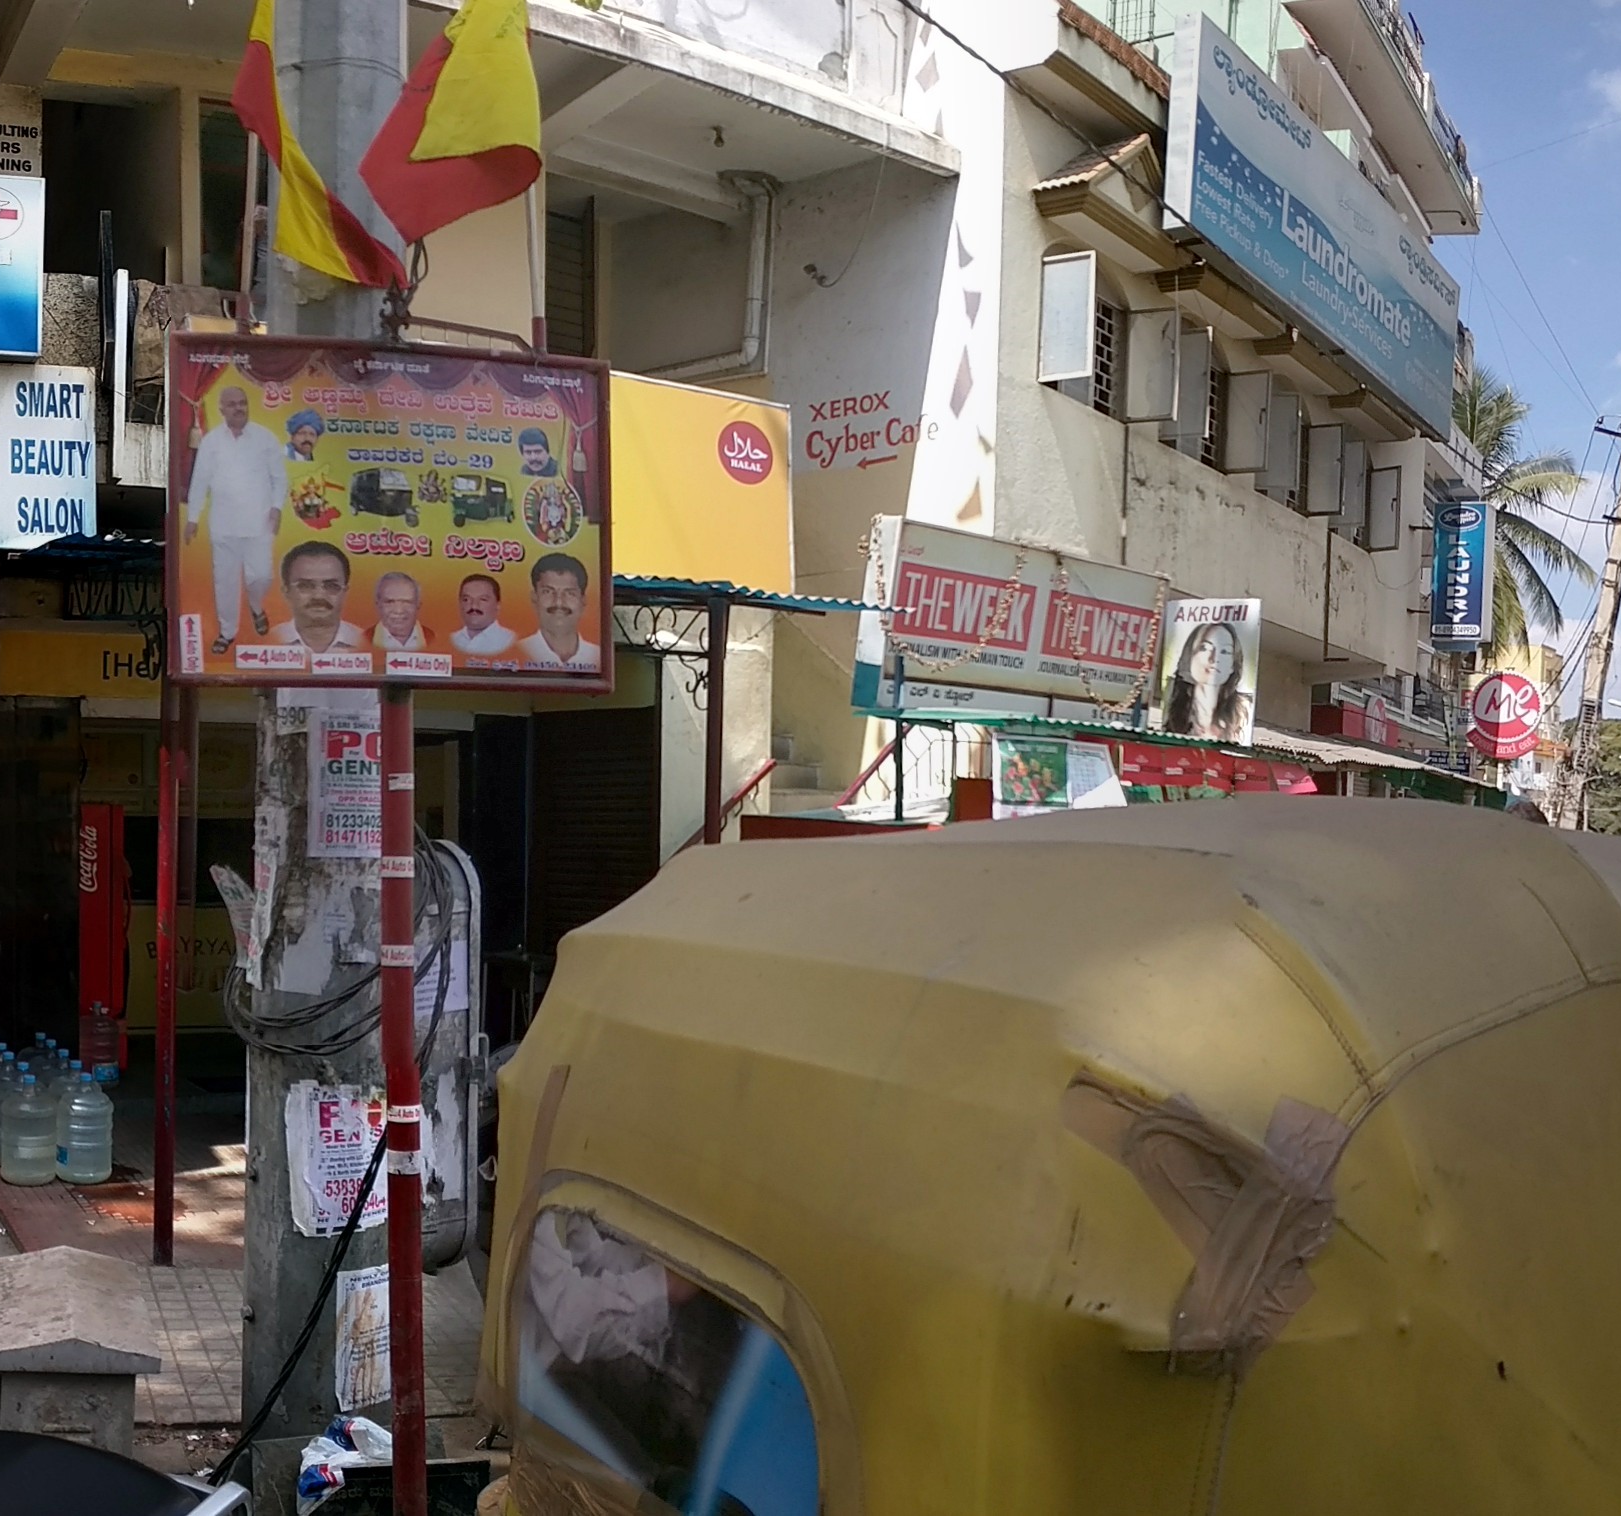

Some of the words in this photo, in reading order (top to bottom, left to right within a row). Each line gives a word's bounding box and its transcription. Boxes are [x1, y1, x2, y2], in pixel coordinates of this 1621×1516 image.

[1196, 172, 1232, 214] Lowest
[1234, 202, 1255, 232] Rate
[1197, 150, 1233, 192] Fastest
[1236, 183, 1274, 229] Delivery
[1194, 194, 1217, 224] Free
[1219, 217, 1252, 254] Pickup
[1281, 188, 1412, 349] Laundromate
[15, 381, 84, 418] SMART
[263, 384, 292, 409] ಶ್ರೀ
[809, 390, 890, 423] XEROX
[326, 416, 400, 437] ಕರ್ನಾಟಕ
[10, 438, 91, 478] BEAUTY
[724, 431, 768, 460] حلال
[805, 422, 881, 469] Cyber
[731, 459, 763, 473] HALAL
[18, 497, 83, 534] SALON
[1446, 534, 1470, 623] LAUNDRY
[1173, 604, 1249, 624] AKRUTHI
[259, 649, 268, 663] 4
[270, 650, 287, 662] Auto
[288, 651, 304, 665] Only
[337, 657, 354, 669] Auto
[355, 657, 371, 672] Only
[414, 658, 433, 670] Auto
[433, 658, 450, 675] Only
